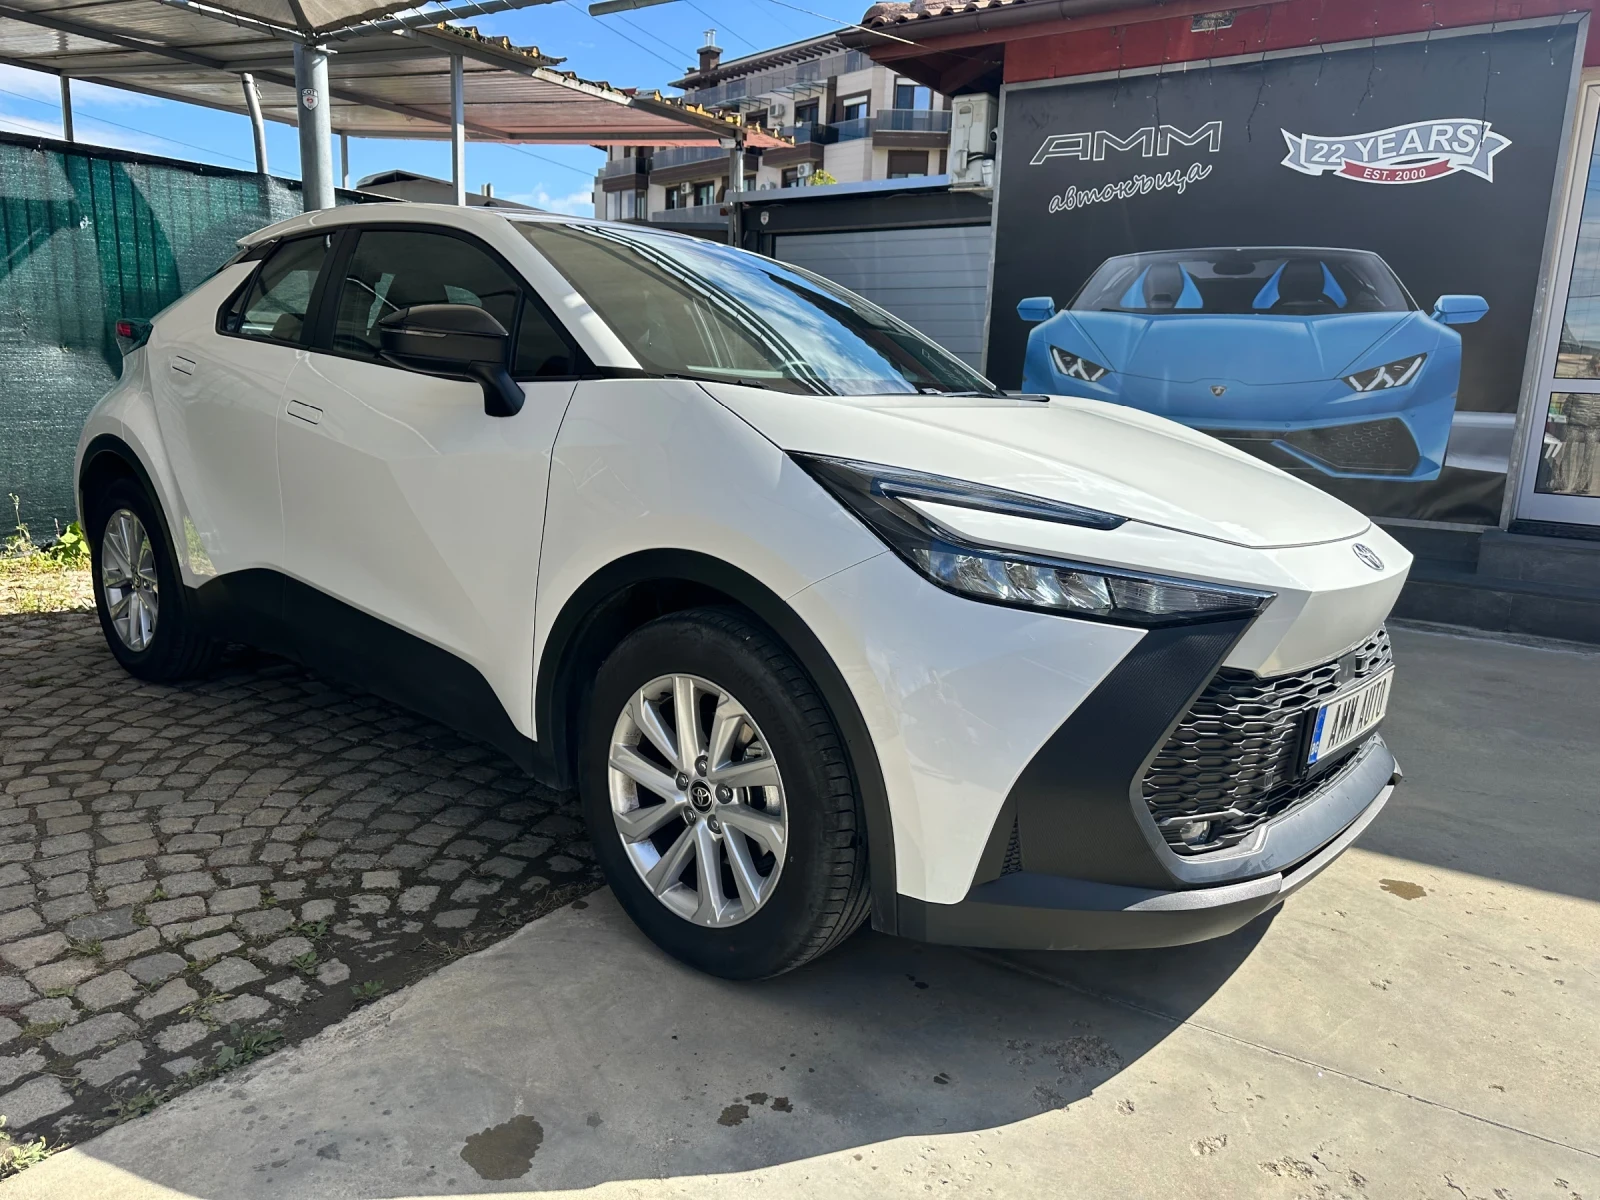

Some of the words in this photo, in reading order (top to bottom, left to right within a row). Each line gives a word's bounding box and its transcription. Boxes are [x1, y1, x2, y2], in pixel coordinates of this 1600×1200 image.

[1029, 121, 1222, 165] AMM
[1311, 143, 1346, 163] 22
[1354, 124, 1479, 163] YEARS
[1049, 162, 1212, 213] автокъща
[1363, 168, 1391, 181] EST.
[1394, 168, 1427, 181] 2000
[1326, 694, 1360, 750] AMM
[1355, 677, 1387, 732] AUTO
